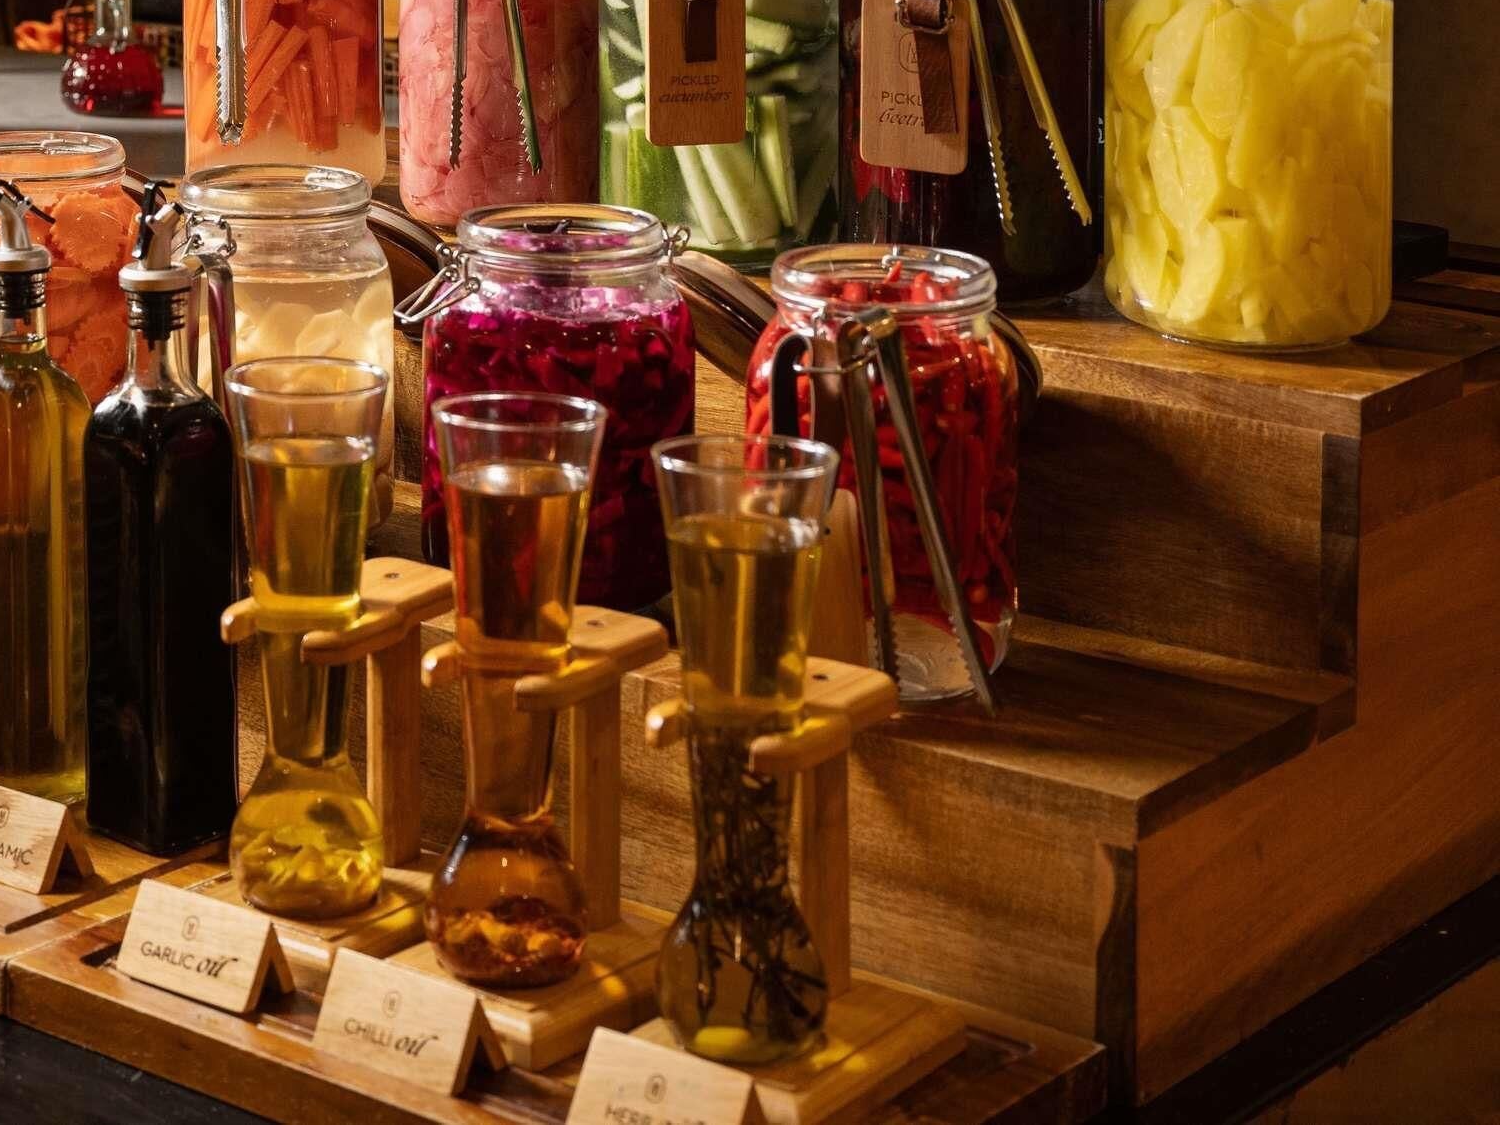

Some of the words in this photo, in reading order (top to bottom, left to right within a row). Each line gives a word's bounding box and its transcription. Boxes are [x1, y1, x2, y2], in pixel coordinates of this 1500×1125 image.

[670, 74, 720, 86] PICKLED
[658, 87, 733, 103] cucumbers
[880, 90, 923, 107] PICKL
[879, 108, 925, 127] beetr
[140, 941, 196, 970] GARLIC
[195, 955, 239, 978] oil
[343, 1017, 395, 1047] CHILLI
[394, 1034, 439, 1057] oil
